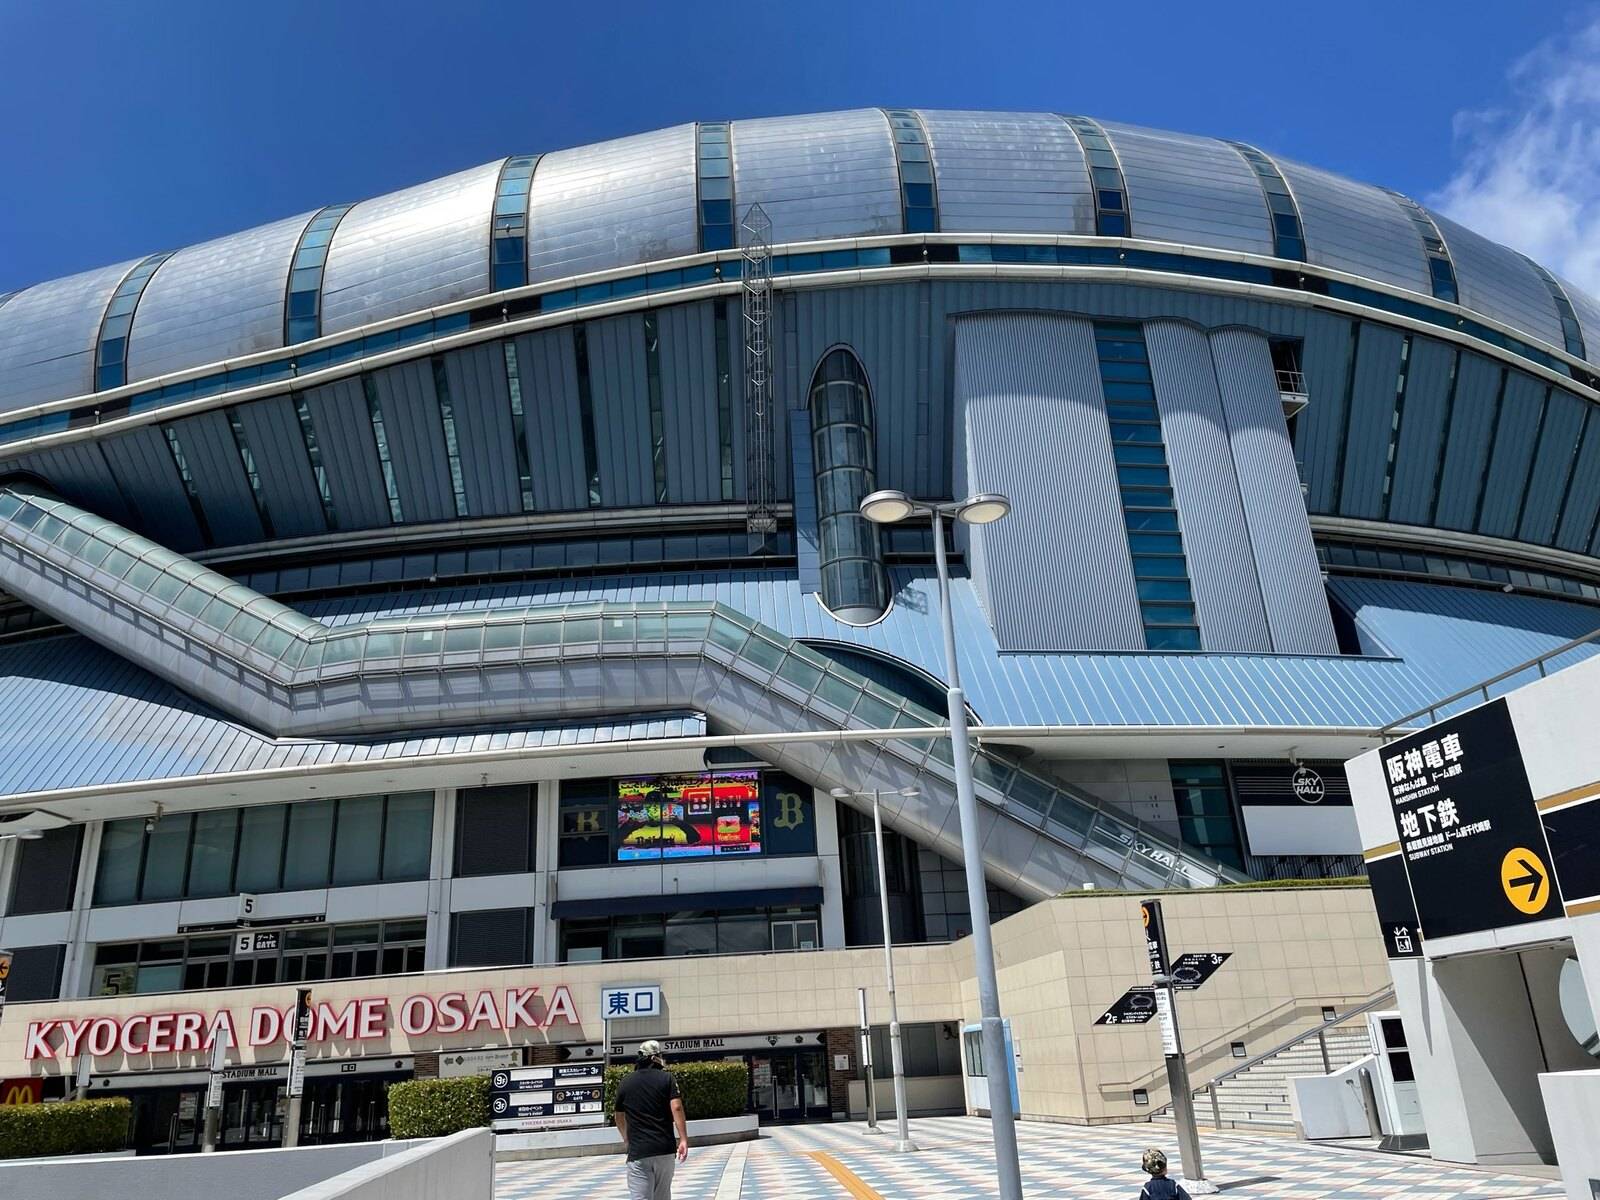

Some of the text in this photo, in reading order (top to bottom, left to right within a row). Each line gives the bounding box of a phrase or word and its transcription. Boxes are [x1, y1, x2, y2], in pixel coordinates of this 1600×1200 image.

[1386, 733, 1464, 784] 阪神電車
[1297, 777, 1320, 785] SKY
[1296, 786, 1323, 794] HALL
[1417, 784, 1440, 798] STATION
[1400, 798, 1460, 838] 地下鉄
[1120, 834, 1152, 853] SKY
[1408, 842, 1454, 861] SUBWAY STATION
[244, 899, 253, 913] 5
[240, 937, 250, 950] 5
[256, 940, 277, 949] GATE
[1210, 953, 1223, 965] 3F
[105, 974, 121, 996] 5
[608, 991, 653, 1015] 東口
[25, 1010, 237, 1059] KYOCERA
[249, 998, 388, 1047] DOME
[401, 985, 581, 1036] OSAKA
[1105, 1012, 1118, 1025] 2F
[665, 1039, 725, 1049] STADIUM MALL
[222, 1068, 277, 1079] STADIUM MALL
[590, 1067, 599, 1075] 3F
[496, 1076, 506, 1086] 9F
[495, 1101, 505, 1110] 3F
